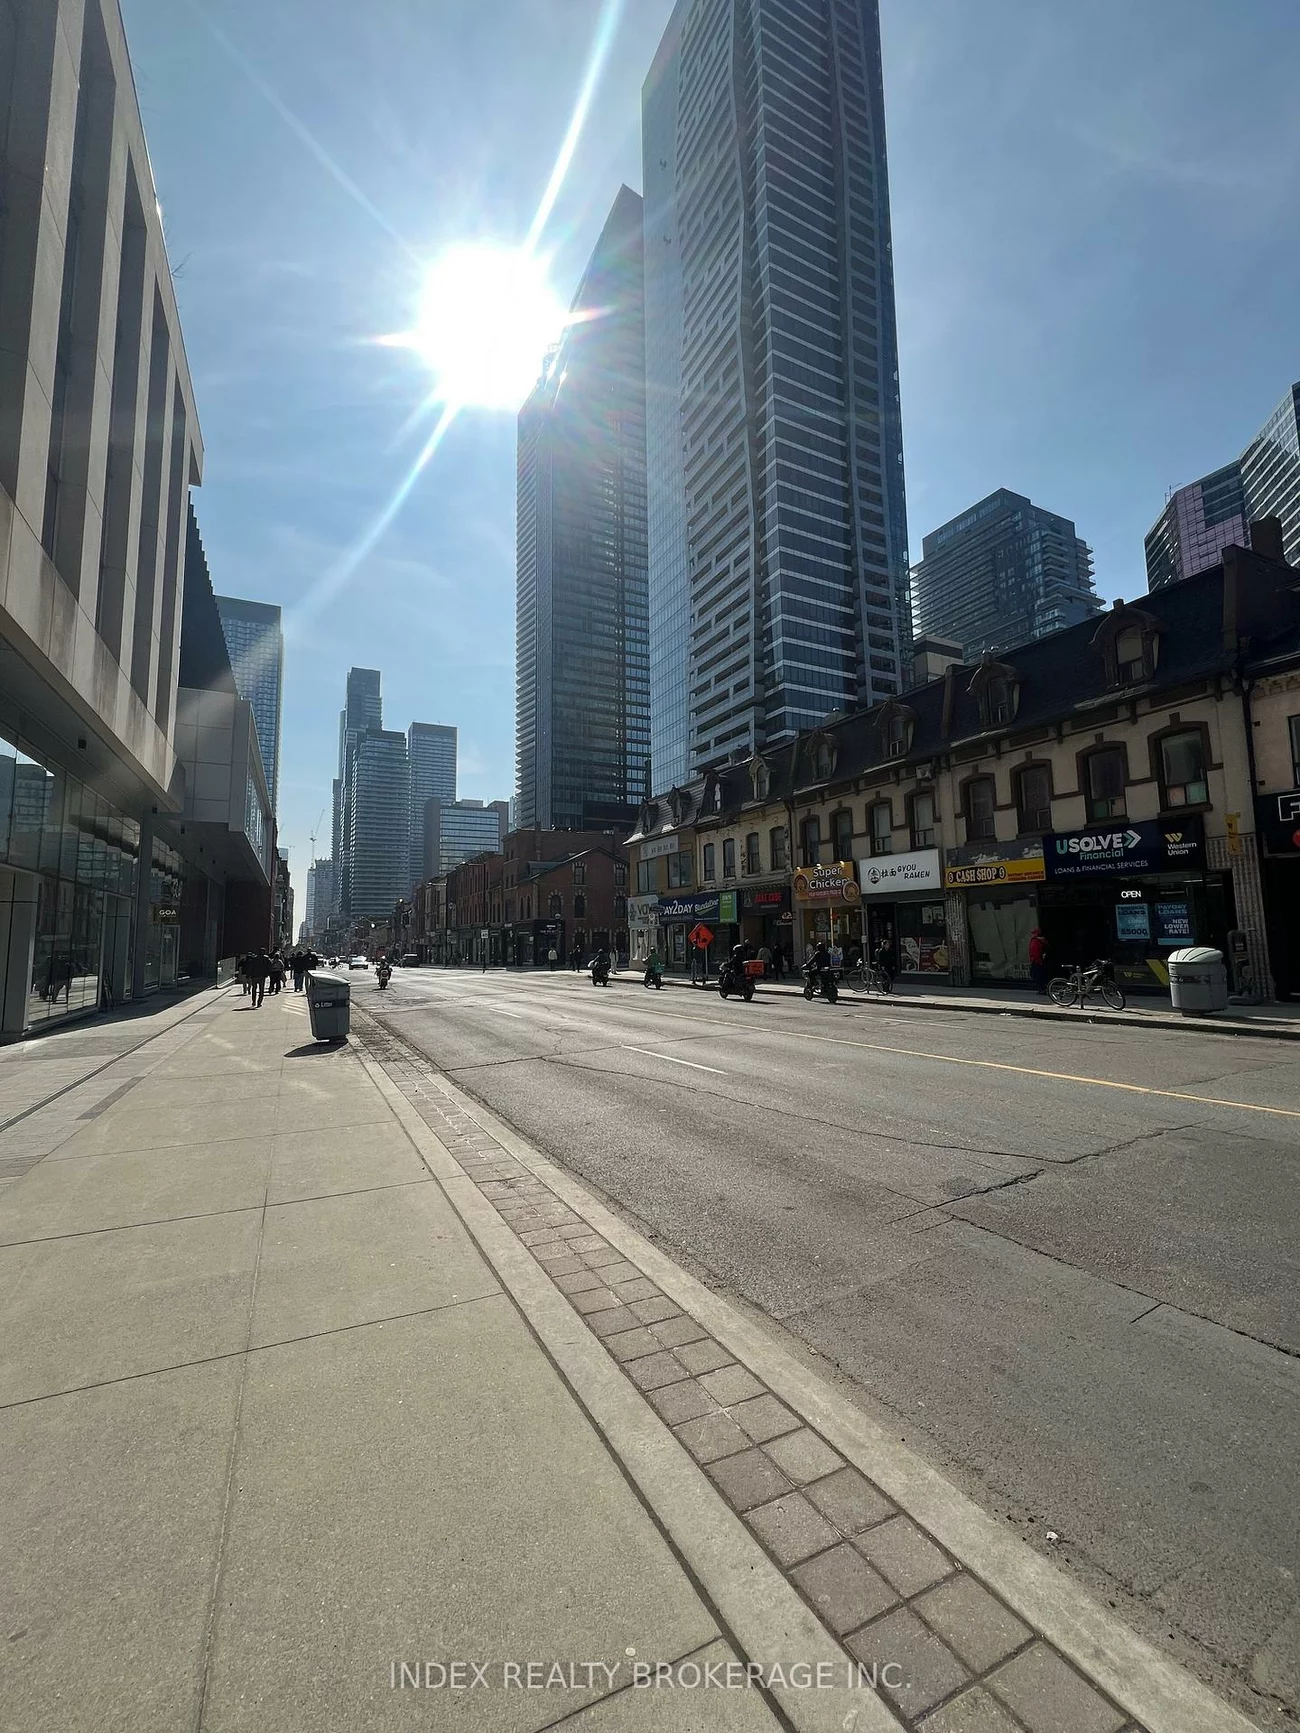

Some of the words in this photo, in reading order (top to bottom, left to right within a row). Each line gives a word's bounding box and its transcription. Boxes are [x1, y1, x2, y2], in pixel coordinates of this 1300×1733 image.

[1055, 832, 1123, 855] USOLVE
[1167, 841, 1197, 850] Western
[1080, 848, 1124, 861] Financial
[1167, 848, 1189, 856] Union
[813, 866, 841, 878] Super
[1054, 867, 1075, 875] LOANS
[1082, 863, 1116, 872] FINANCIAL
[1117, 860, 1149, 869] SERVICES
[904, 870, 931, 880] RAMEN
[809, 877, 850, 890] Chicken
[1120, 890, 1142, 899] OPEN
